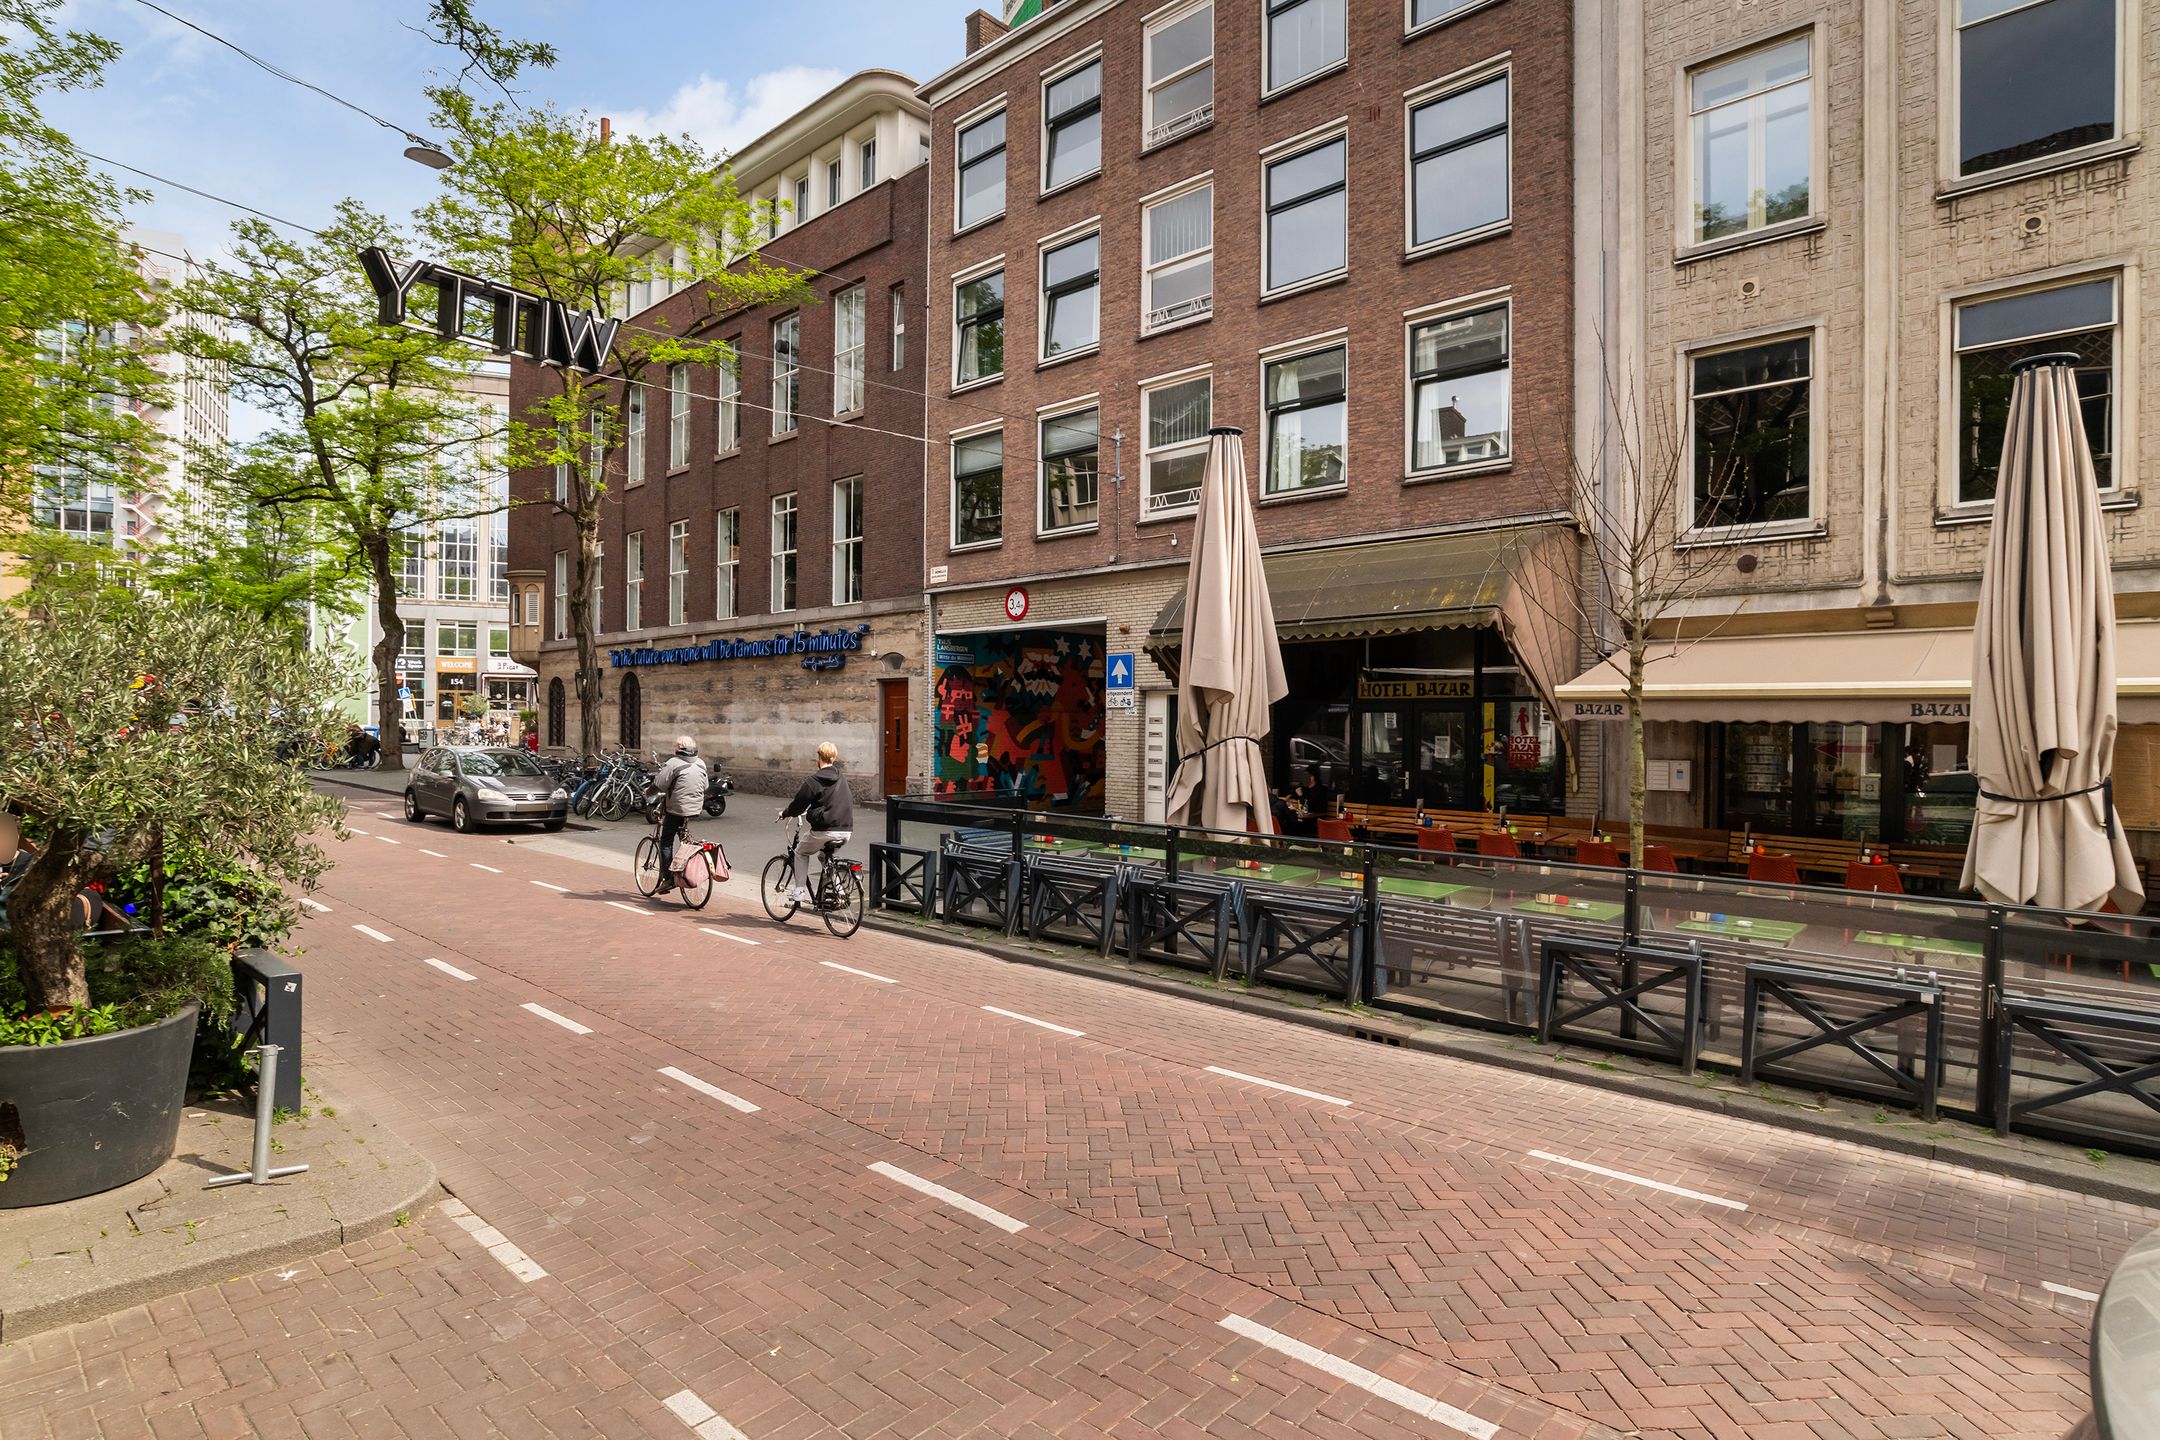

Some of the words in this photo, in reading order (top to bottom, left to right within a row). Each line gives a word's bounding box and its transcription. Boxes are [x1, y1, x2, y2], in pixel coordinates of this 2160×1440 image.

[661, 648, 700, 665] everyone
[702, 641, 718, 661] will
[720, 641, 731, 659] be
[734, 638, 771, 658] famous
[774, 634, 789, 655] for
[793, 632, 806, 653] 15
[441, 661, 473, 669] WELCOME
[1360, 683, 1412, 697] HOTEL
[1416, 682, 1472, 697] BAZAR
[1574, 703, 1625, 715] BAZAR
[1509, 736, 1540, 744] HOTEL
[1509, 744, 1540, 752] BAZAR
